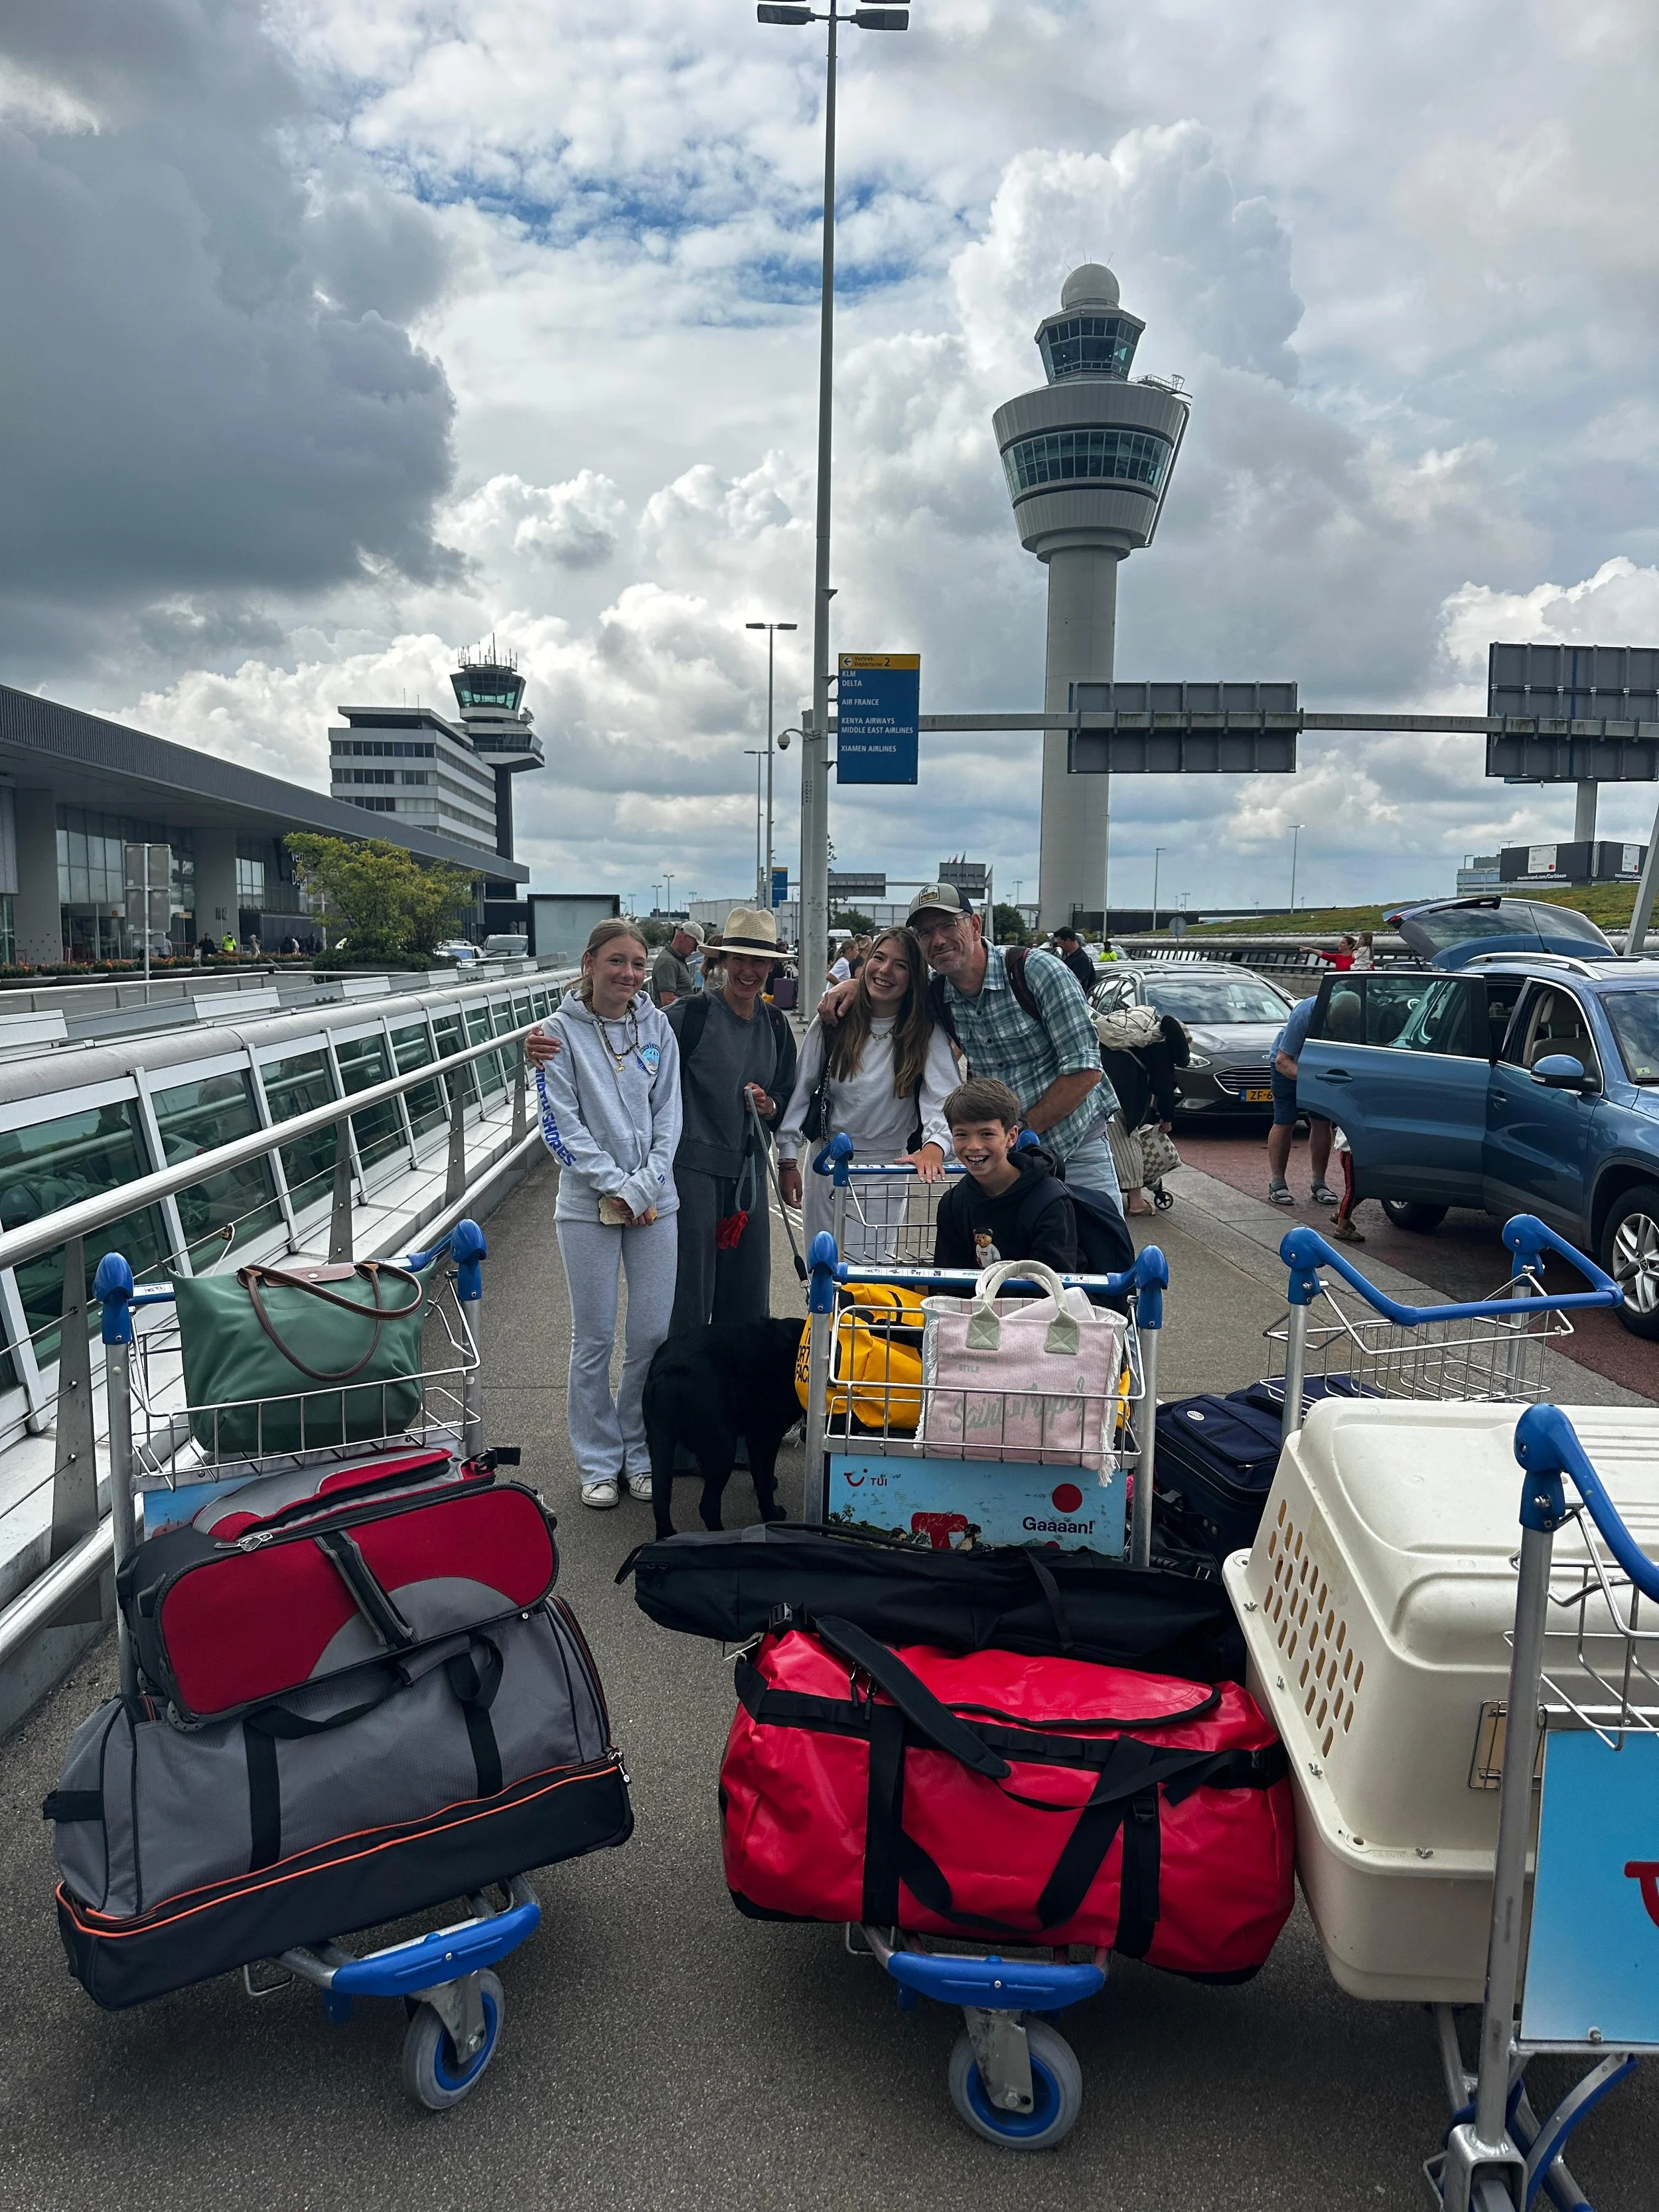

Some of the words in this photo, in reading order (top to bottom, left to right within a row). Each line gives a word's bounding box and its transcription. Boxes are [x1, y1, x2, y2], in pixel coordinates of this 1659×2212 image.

[885, 658, 891, 666] 2
[535, 1069, 551, 1112] ORTH
[541, 1112, 577, 1167] SHORES
[796, 1364, 810, 1383] FAC
[959, 1364, 979, 1373] STYLE
[870, 1477, 887, 1486] TUI
[1022, 1516, 1094, 1534] Gaaaan!
